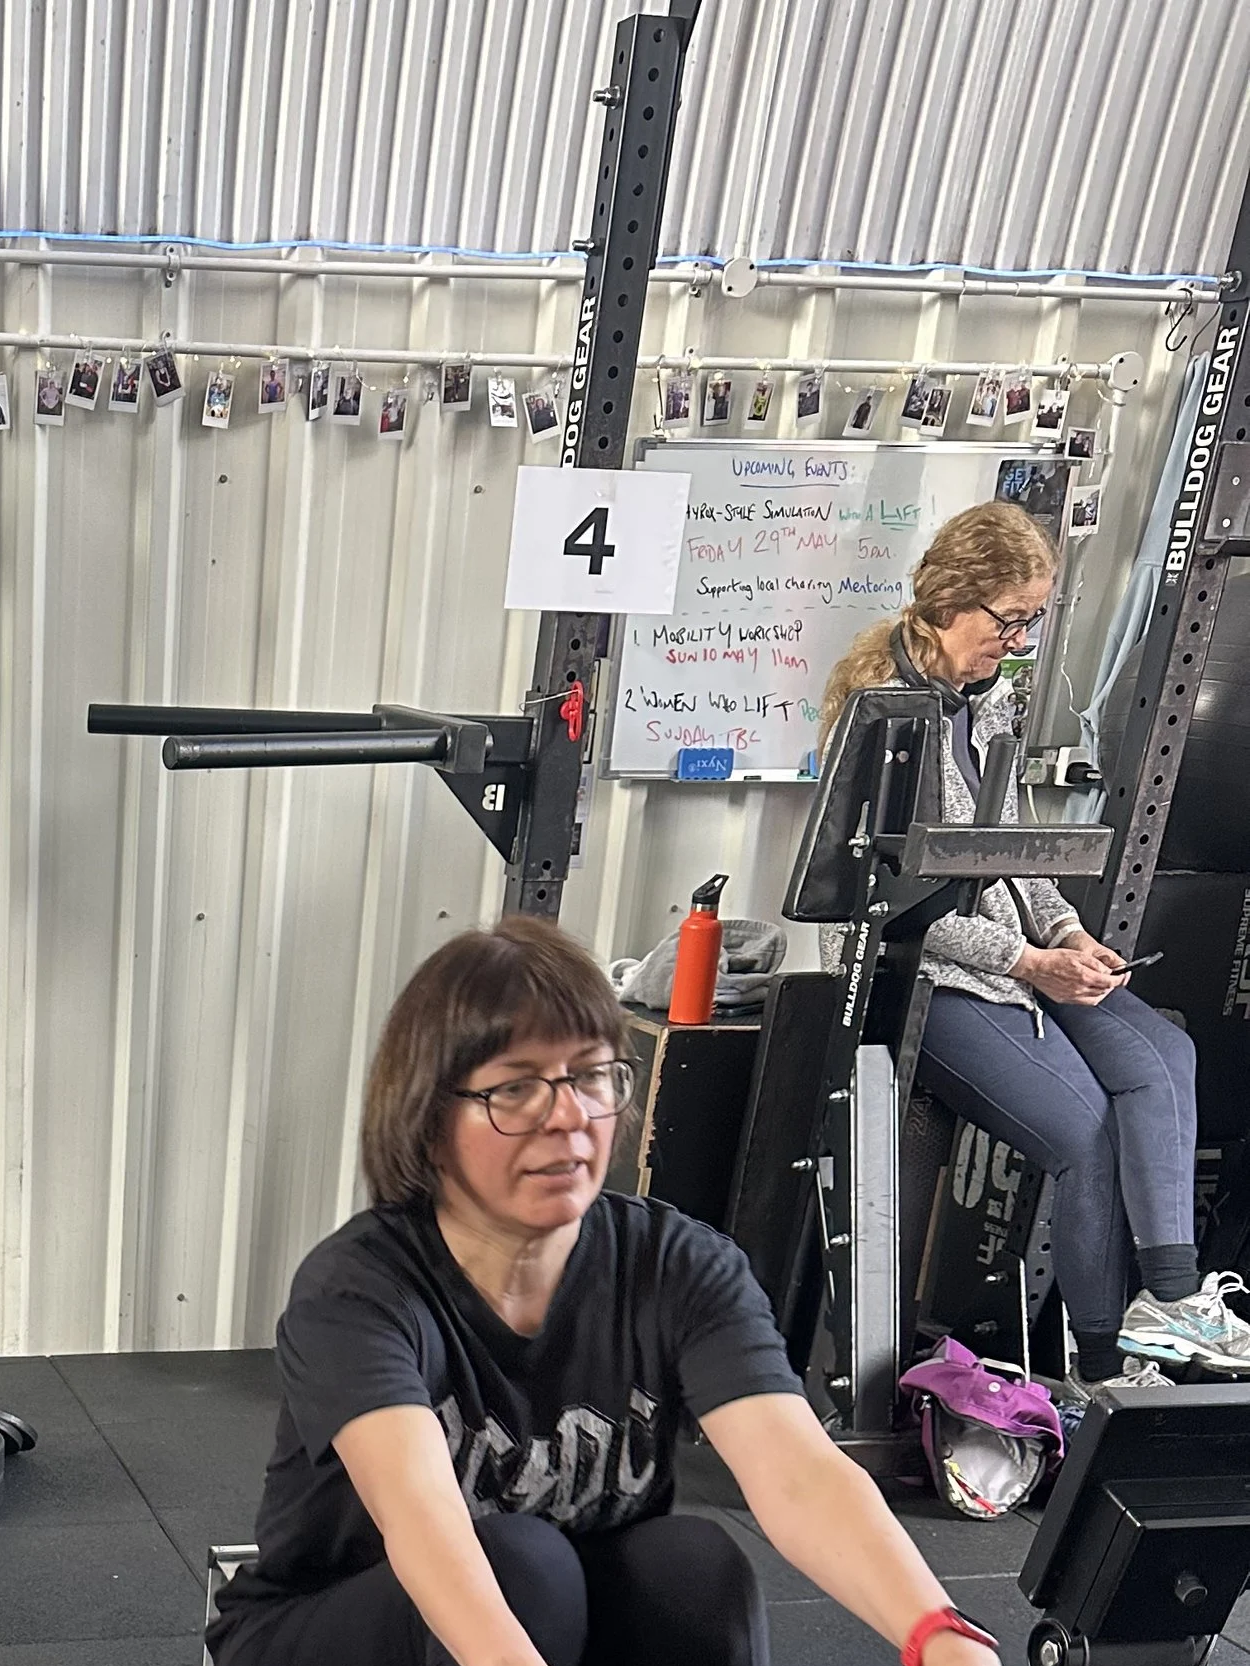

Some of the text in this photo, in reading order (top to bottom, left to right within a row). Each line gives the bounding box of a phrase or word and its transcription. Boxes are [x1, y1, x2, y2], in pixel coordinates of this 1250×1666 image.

[572, 296, 597, 391] GEAR
[1165, 325, 1239, 571] BULLDOG GEAR
[732, 457, 796, 479] UPCOMING
[563, 507, 615, 575] 4
[687, 534, 742, 562] FRIDAY
[797, 531, 840, 554] MAY
[757, 576, 780, 592] local
[838, 577, 903, 598] Mentoring
[653, 622, 732, 648] MOBILITY
[666, 649, 697, 664] SUN
[703, 649, 717, 662] 10
[723, 649, 759, 673] MAY
[744, 692, 794, 721] LIFT
[842, 921, 871, 1028] BULLDOG GEAR
